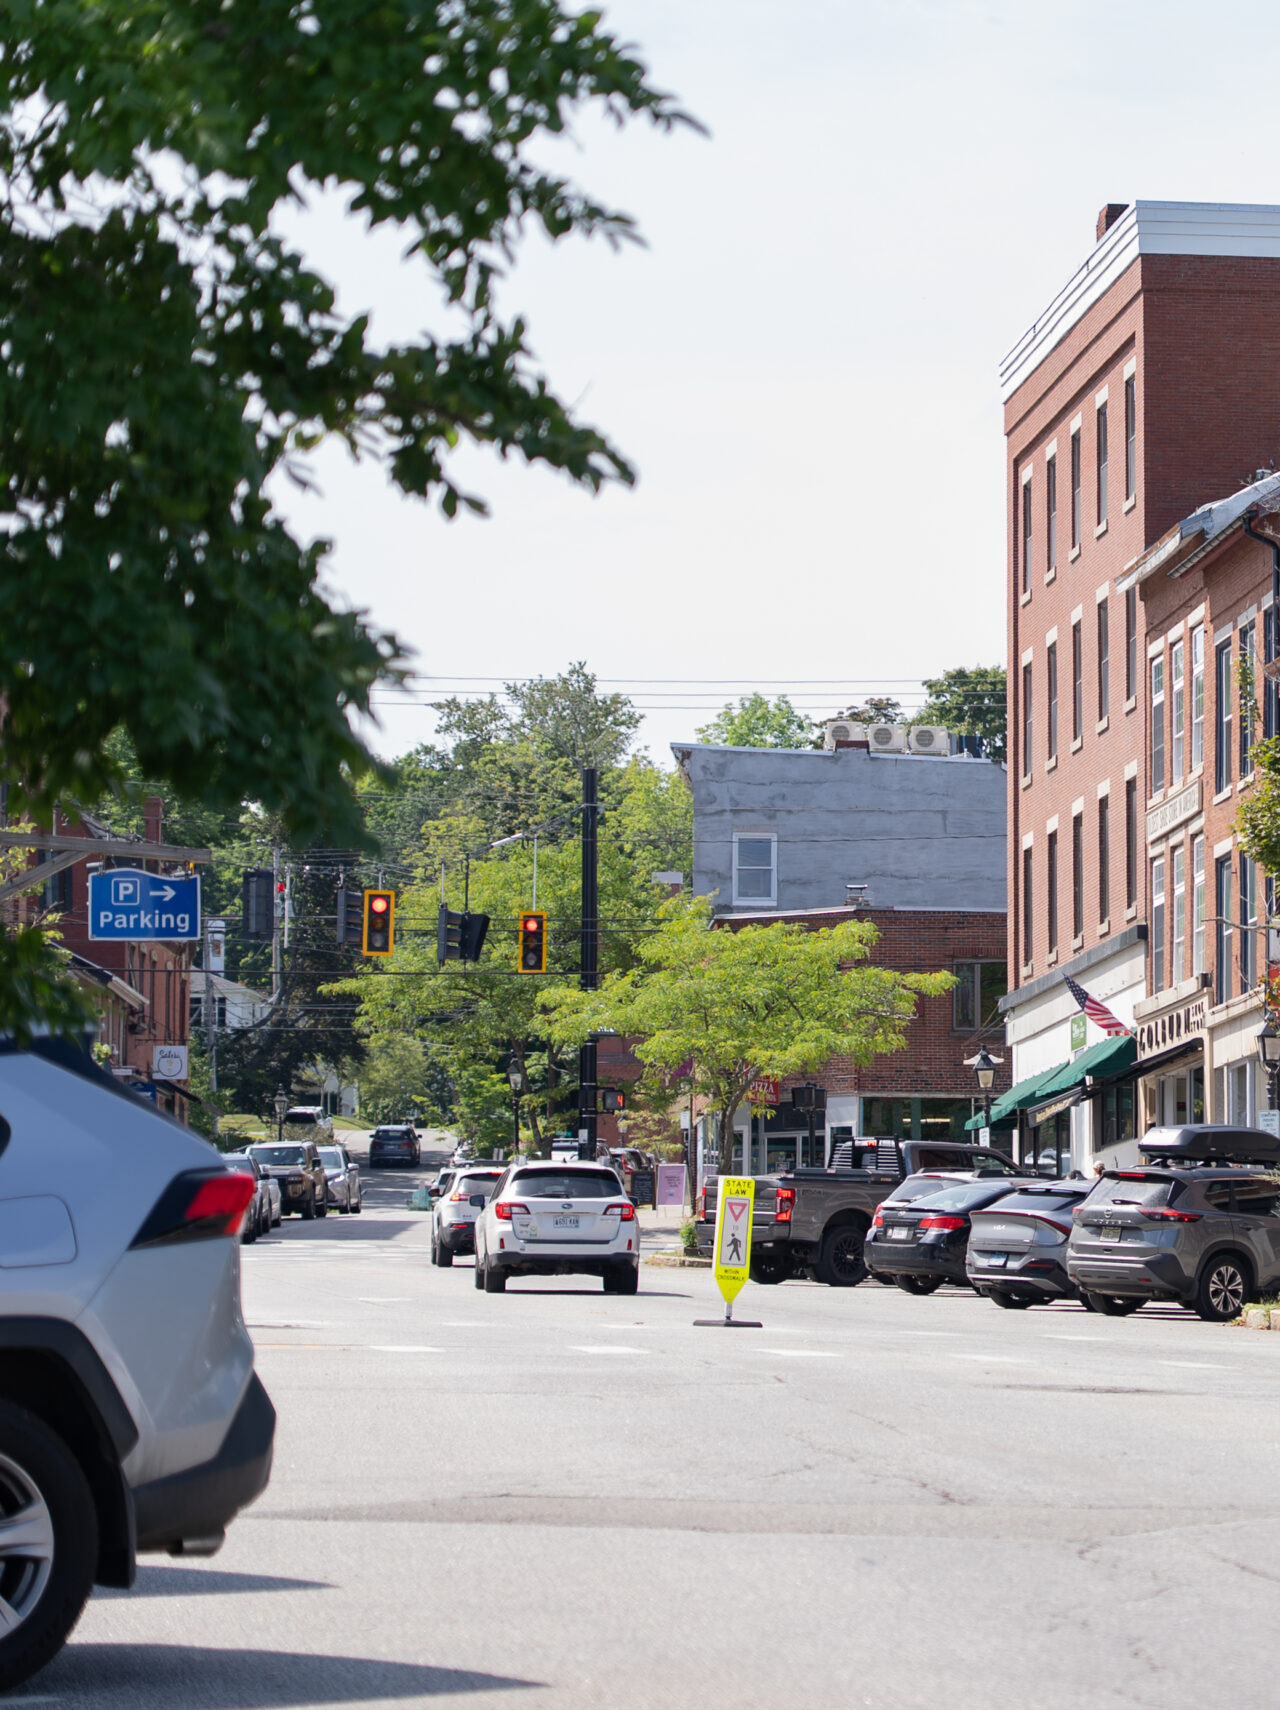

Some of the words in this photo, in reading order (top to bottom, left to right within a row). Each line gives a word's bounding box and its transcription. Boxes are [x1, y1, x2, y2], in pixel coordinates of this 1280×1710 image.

[119, 883, 134, 901] P
[100, 910, 190, 933] Parking
[1139, 1009, 1191, 1053] COLBURN
[750, 1081, 774, 1094] PIZZA
[617, 1095, 623, 1107] 4
[726, 1180, 751, 1188] STATE
